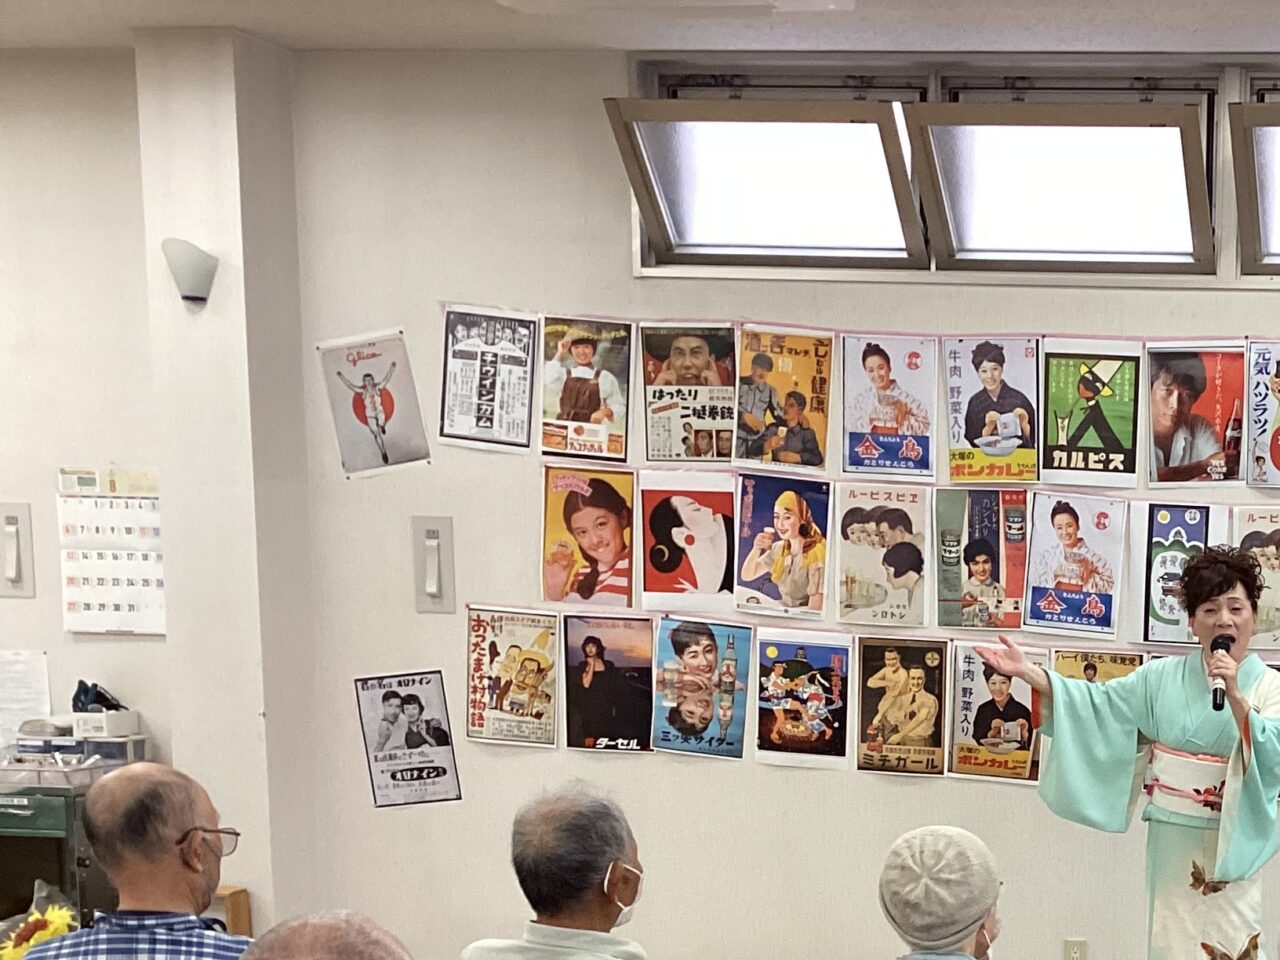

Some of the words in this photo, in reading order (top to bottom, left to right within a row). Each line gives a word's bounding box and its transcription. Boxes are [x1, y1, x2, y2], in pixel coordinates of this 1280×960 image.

[948, 349, 962, 378] 牛肉
[1253, 347, 1272, 376] 元気
[476, 351, 498, 429] チウインガム
[652, 388, 698, 401] はったり
[949, 386, 963, 444] 野菜入り
[863, 459, 915, 468] かとりせんこう
[1052, 450, 1125, 470] カルピス
[951, 463, 1036, 477] ボンカレー
[125, 527, 132, 535] 10
[82, 552, 89, 560] 14
[112, 552, 119, 561] 16
[126, 553, 134, 561] 17
[141, 553, 149, 561] 18
[82, 577, 89, 586] 21
[96, 577, 105, 586] 22
[112, 578, 120, 586] 23
[126, 578, 135, 587] 24
[98, 603, 106, 611] 29
[113, 603, 121, 612] 30
[127, 604, 135, 612] 31
[1044, 614, 1096, 625] かとりせんこう
[962, 654, 976, 683] 牛肉
[960, 686, 974, 737] 野菜入り
[595, 737, 641, 750] ターセル
[660, 730, 735, 749] 三ツ矢サイダー
[863, 753, 939, 770] ミチガール
[957, 754, 1027, 770] ボンカレー
